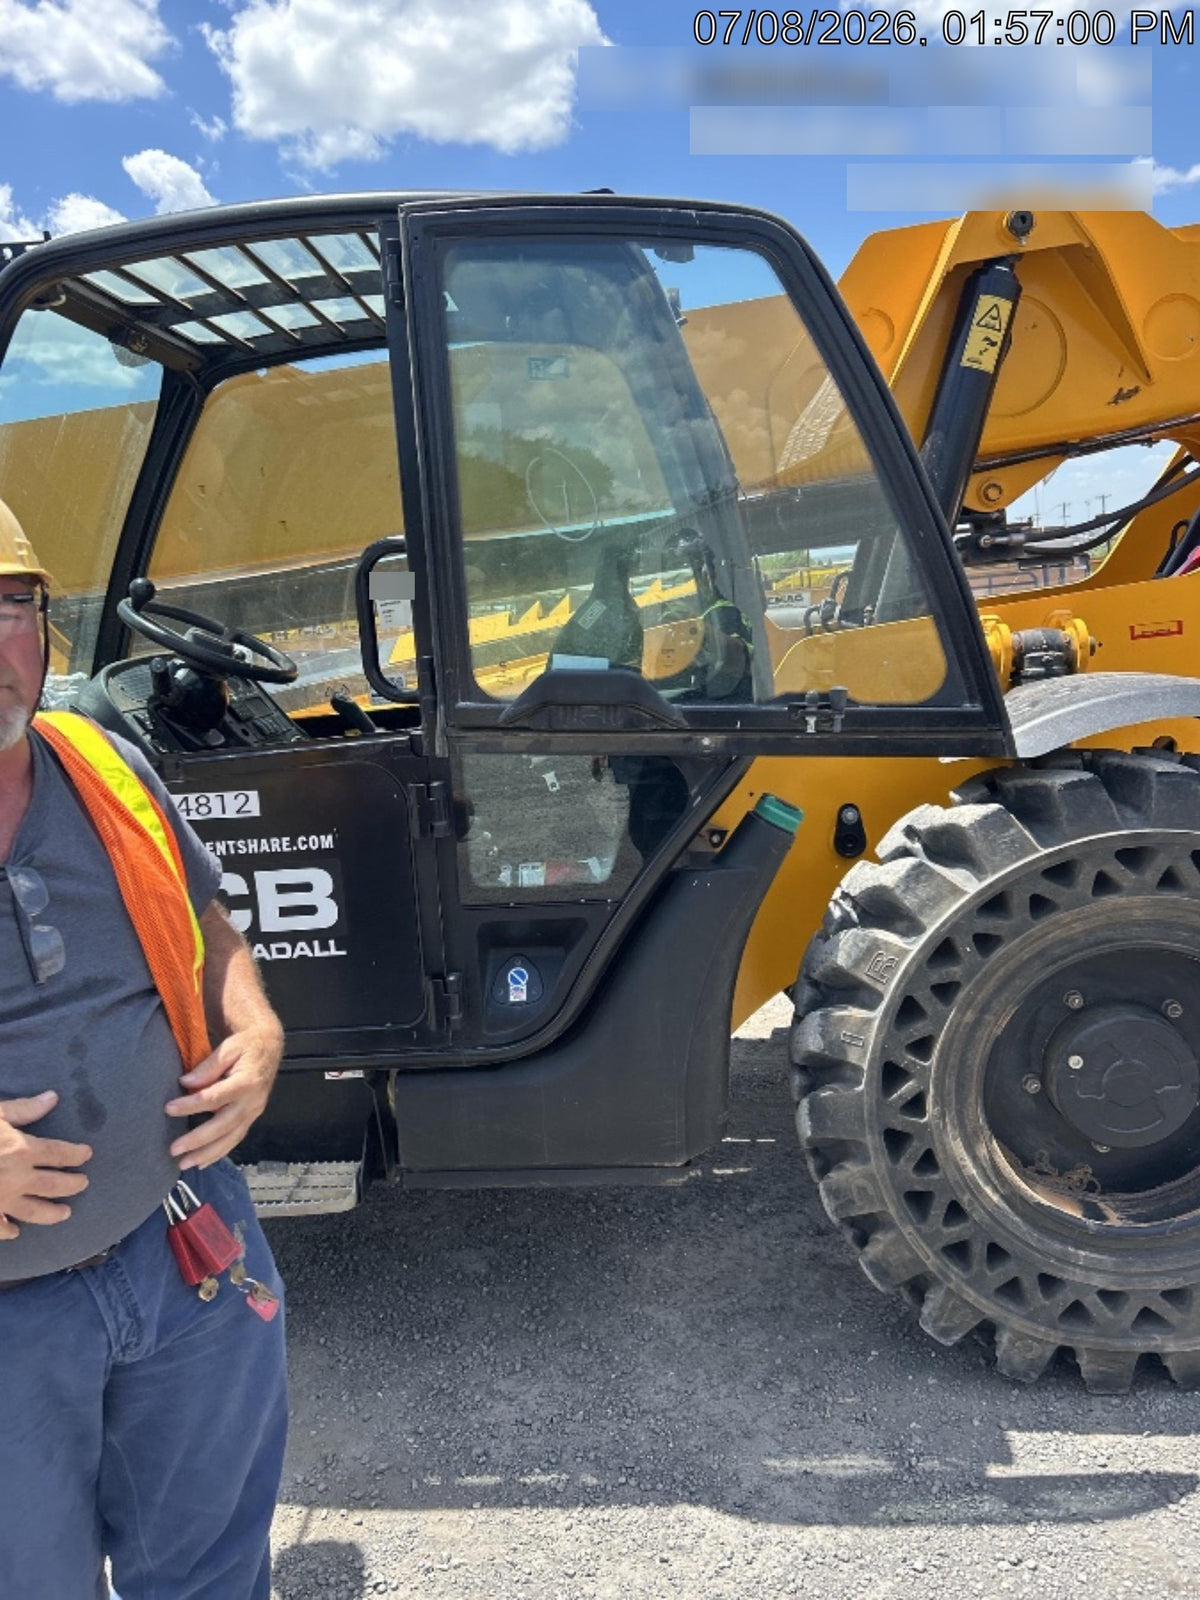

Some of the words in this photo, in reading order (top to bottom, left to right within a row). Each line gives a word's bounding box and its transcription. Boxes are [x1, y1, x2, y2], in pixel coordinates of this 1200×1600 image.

[177, 792, 252, 817] 4812
[204, 833, 335, 857] ENTSHARE.COM
[217, 866, 339, 933] CB
[252, 939, 348, 961] ADALL
